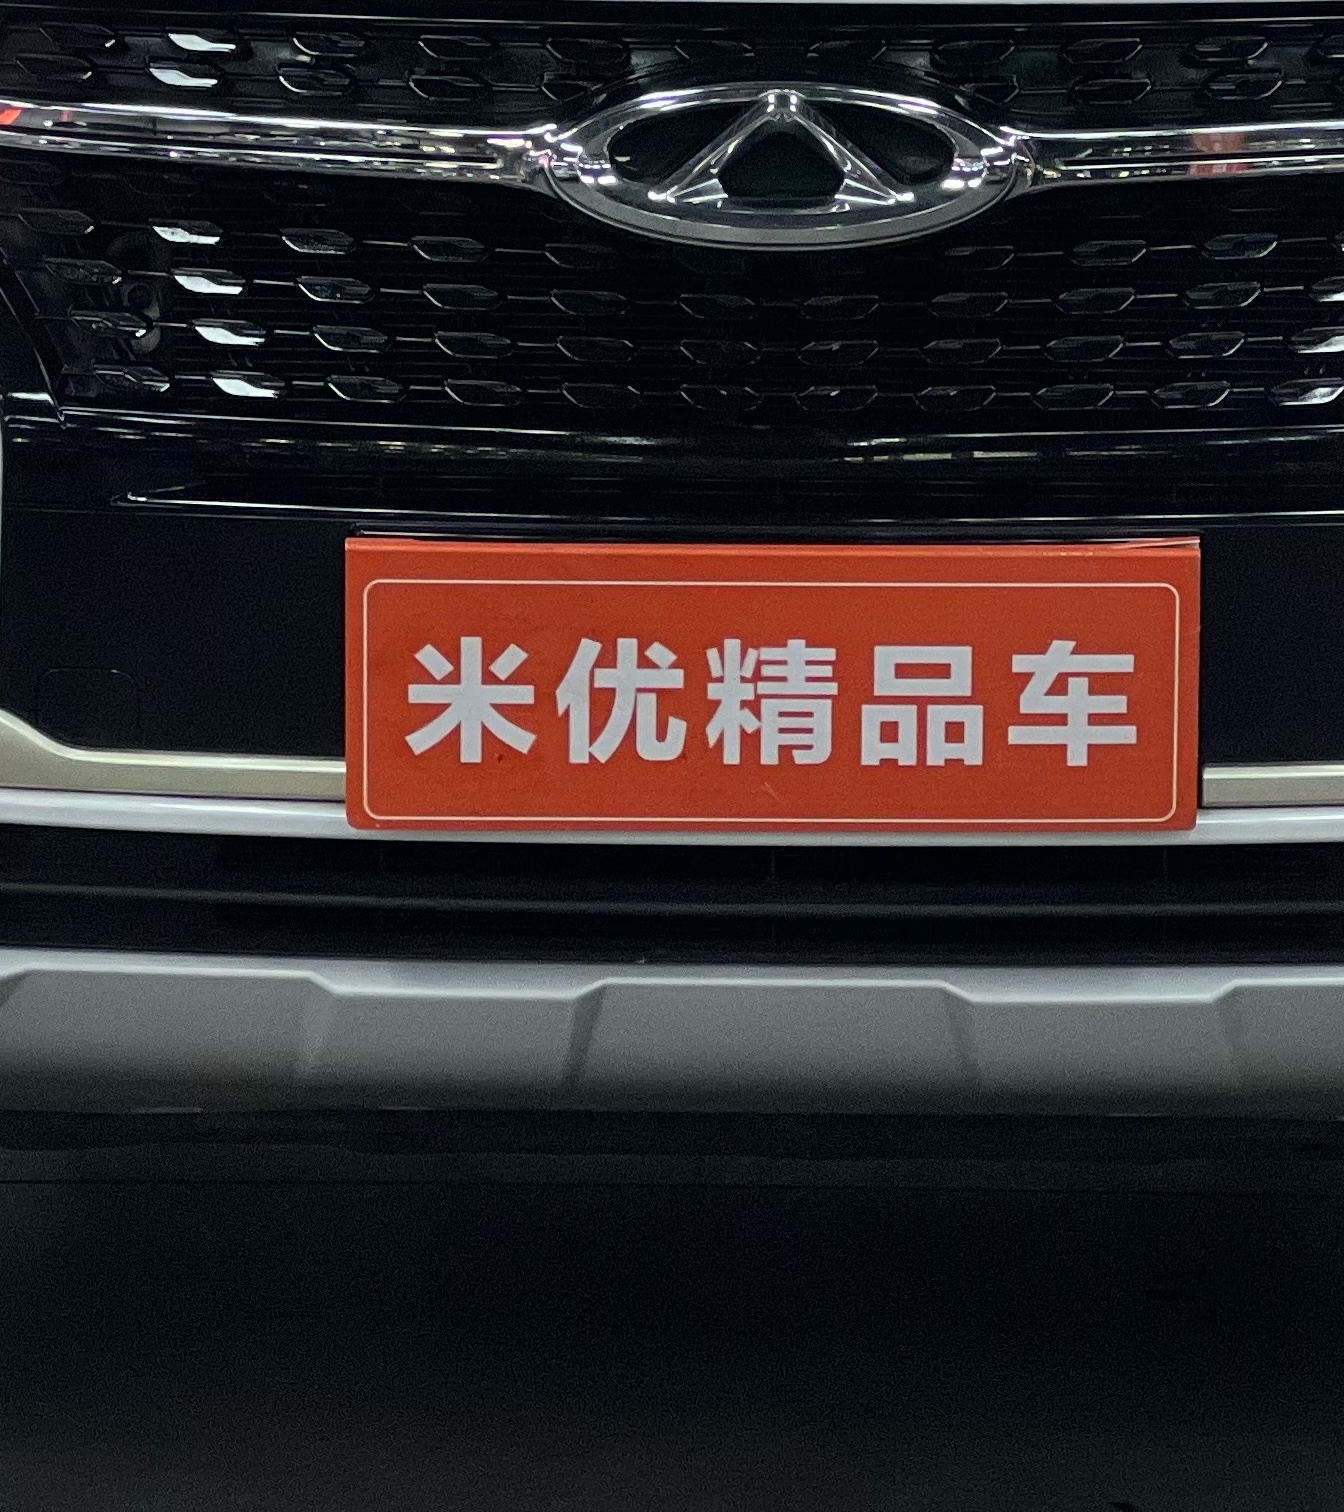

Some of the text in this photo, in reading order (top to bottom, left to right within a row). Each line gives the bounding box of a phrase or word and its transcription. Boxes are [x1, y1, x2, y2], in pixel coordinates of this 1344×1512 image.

[405, 636, 1138, 767] 米优精品车
